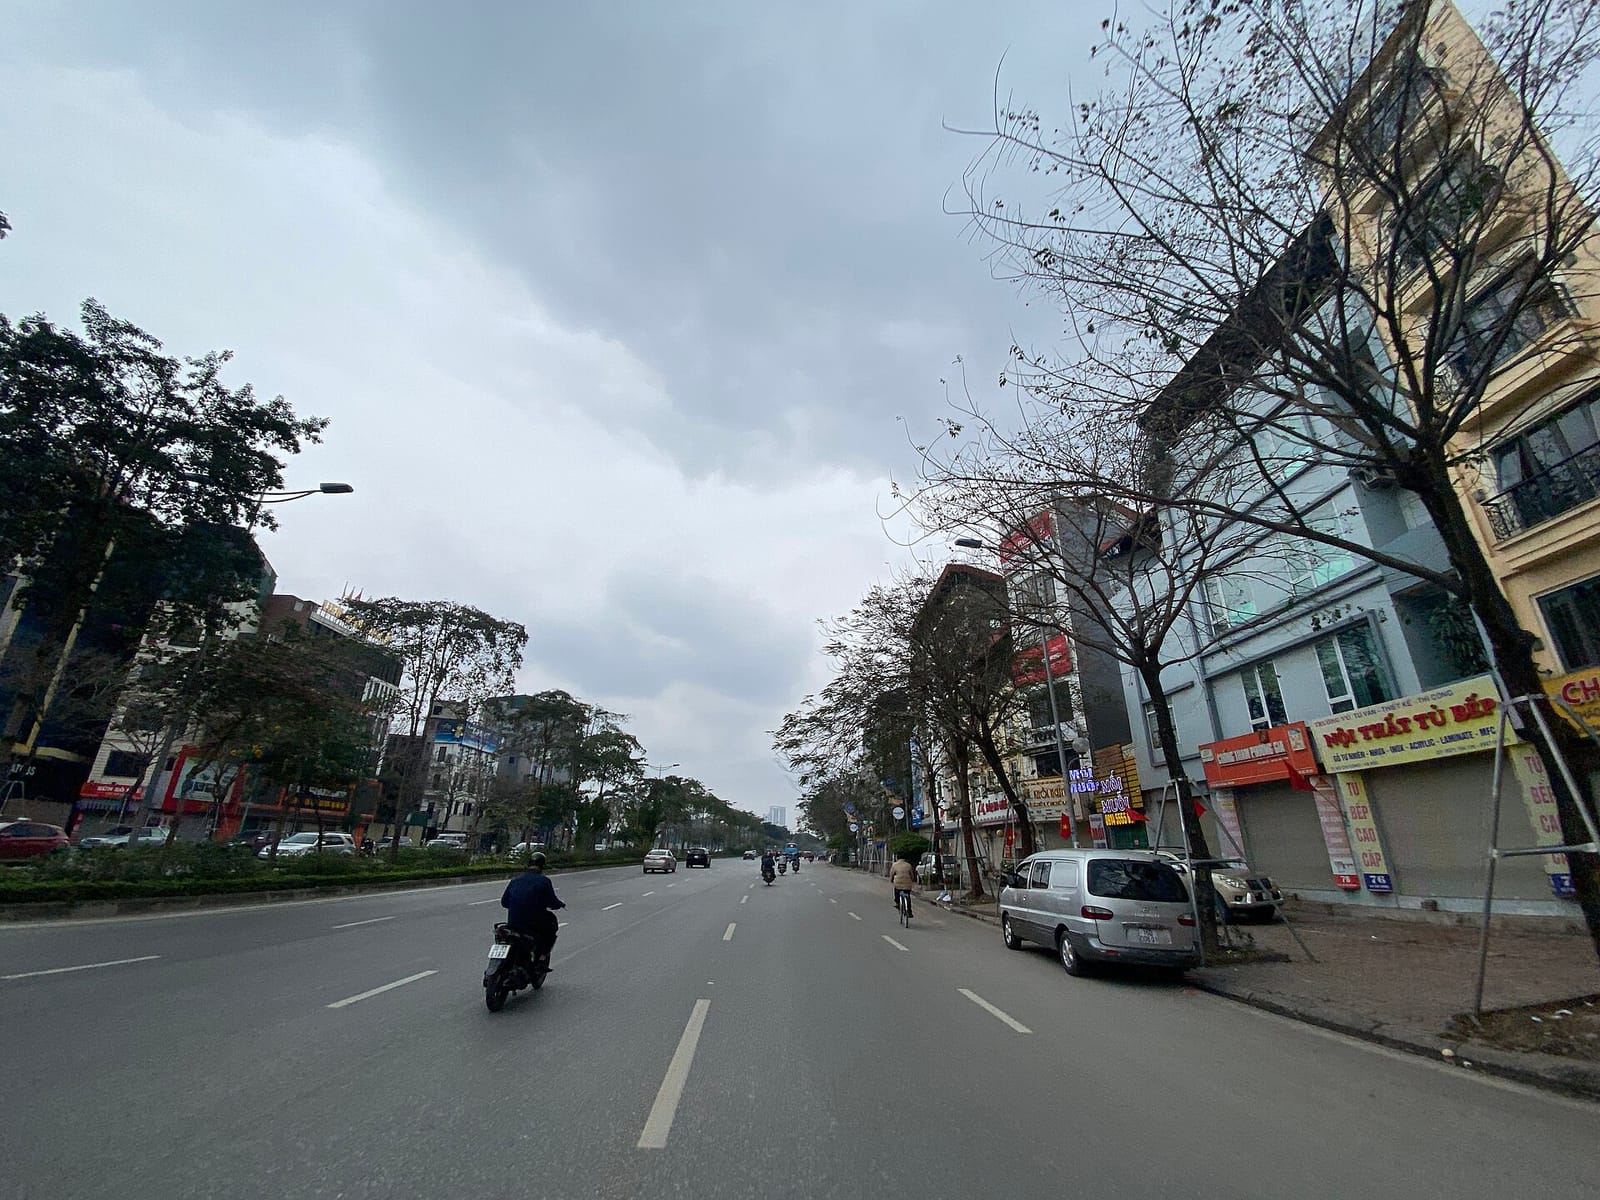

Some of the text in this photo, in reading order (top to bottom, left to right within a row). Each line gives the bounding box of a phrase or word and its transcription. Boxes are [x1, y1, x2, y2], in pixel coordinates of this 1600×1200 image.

[1323, 726, 1358, 748] NỘI
[1358, 713, 1412, 741] THẤT
[1413, 704, 1446, 730] TỦ
[1449, 692, 1497, 722] BẾP
[1440, 730, 1473, 744] LAMINATE
[1479, 726, 1496, 737] MFC
[1355, 828, 1376, 842] CAO
[1369, 875, 1386, 885] 76
